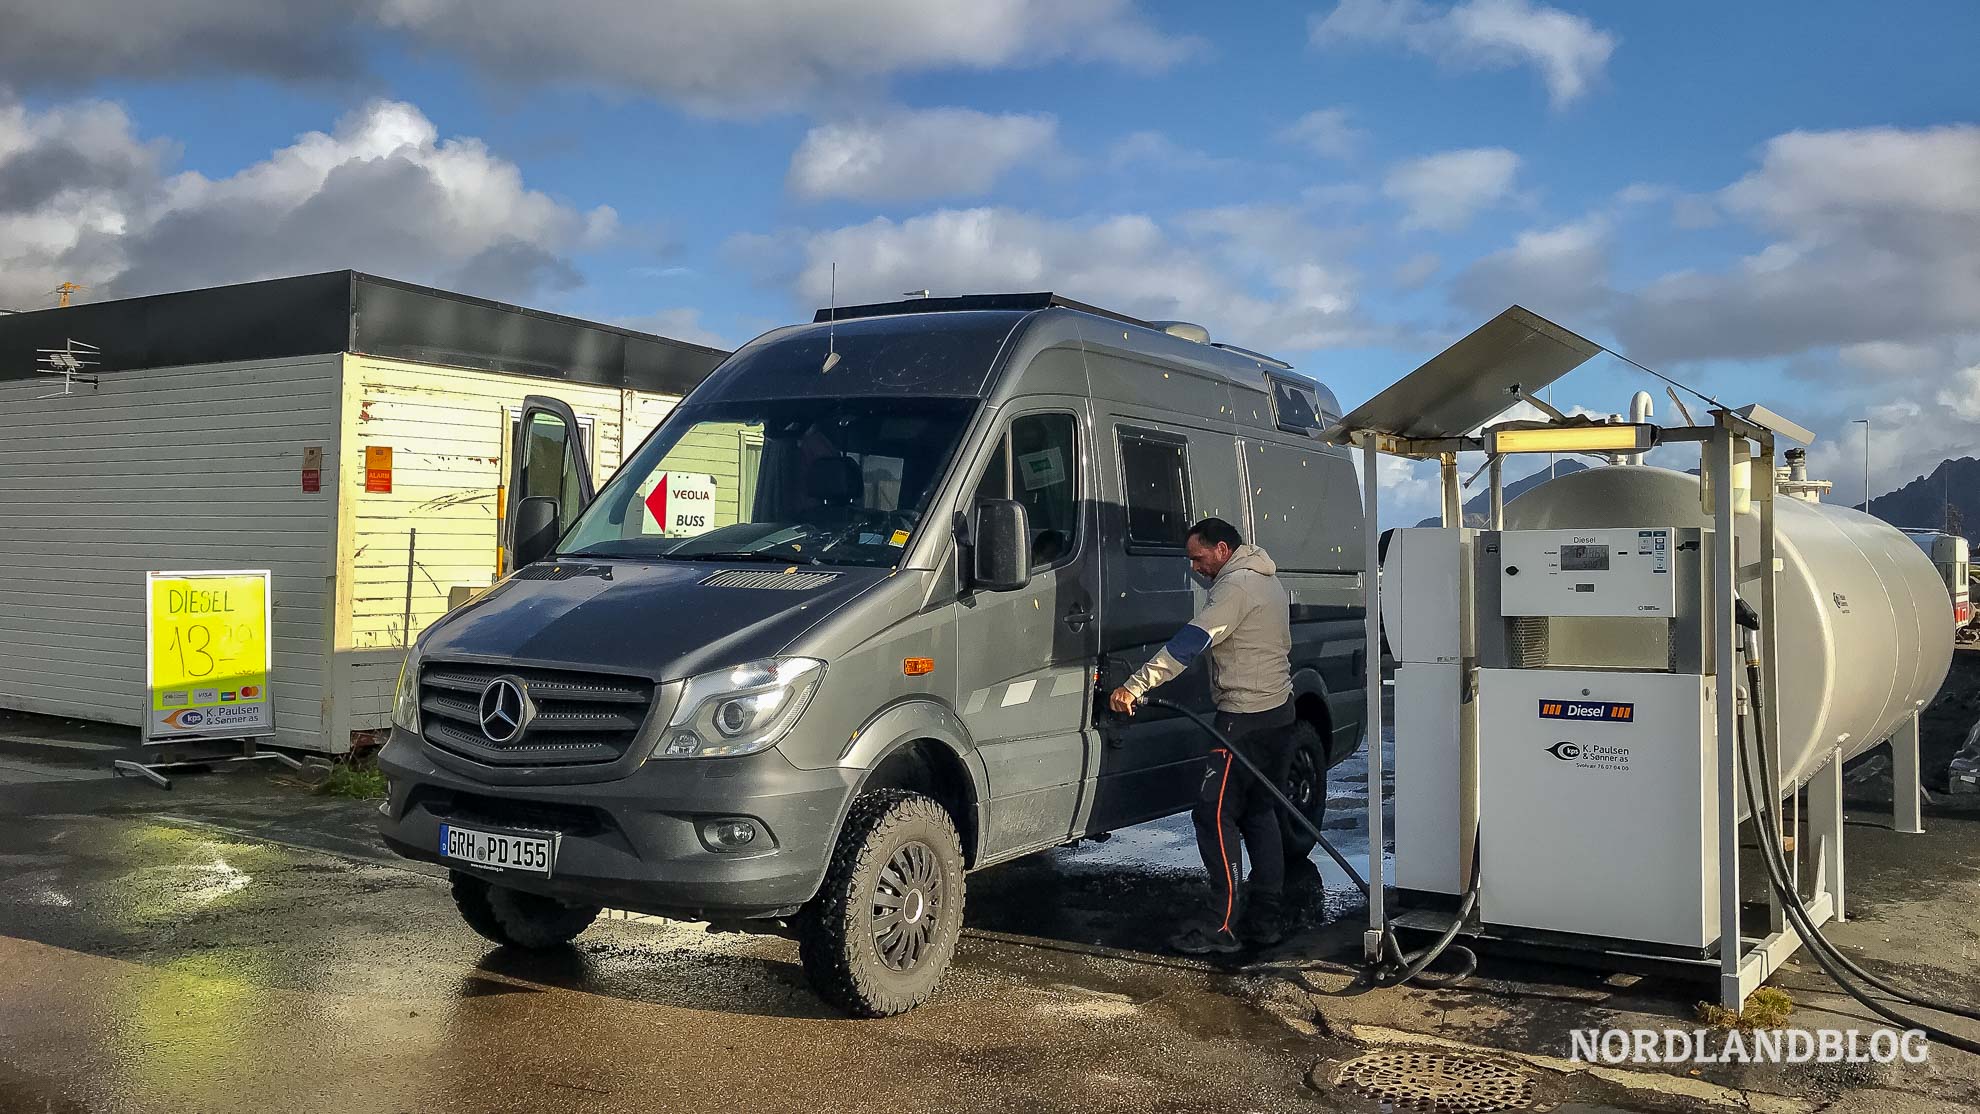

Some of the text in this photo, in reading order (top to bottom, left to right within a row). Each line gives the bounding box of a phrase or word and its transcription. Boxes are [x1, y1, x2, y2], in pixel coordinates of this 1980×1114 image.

[673, 489, 710, 500] VEOLIA
[676, 514, 705, 527] BUSS
[1573, 536, 1596, 544] Diesel
[169, 589, 235, 614] DIESEL
[206, 708, 217, 717] K.
[218, 706, 259, 717] Paulsen
[1567, 704, 1605, 717] Diesel
[215, 716, 247, 725] Sønner
[1567, 744, 1629, 756] kps K. Paulsen
[1590, 753, 1618, 762] Sønner
[442, 842, 447, 851] D
[449, 830, 547, 868] GRH PD 155
